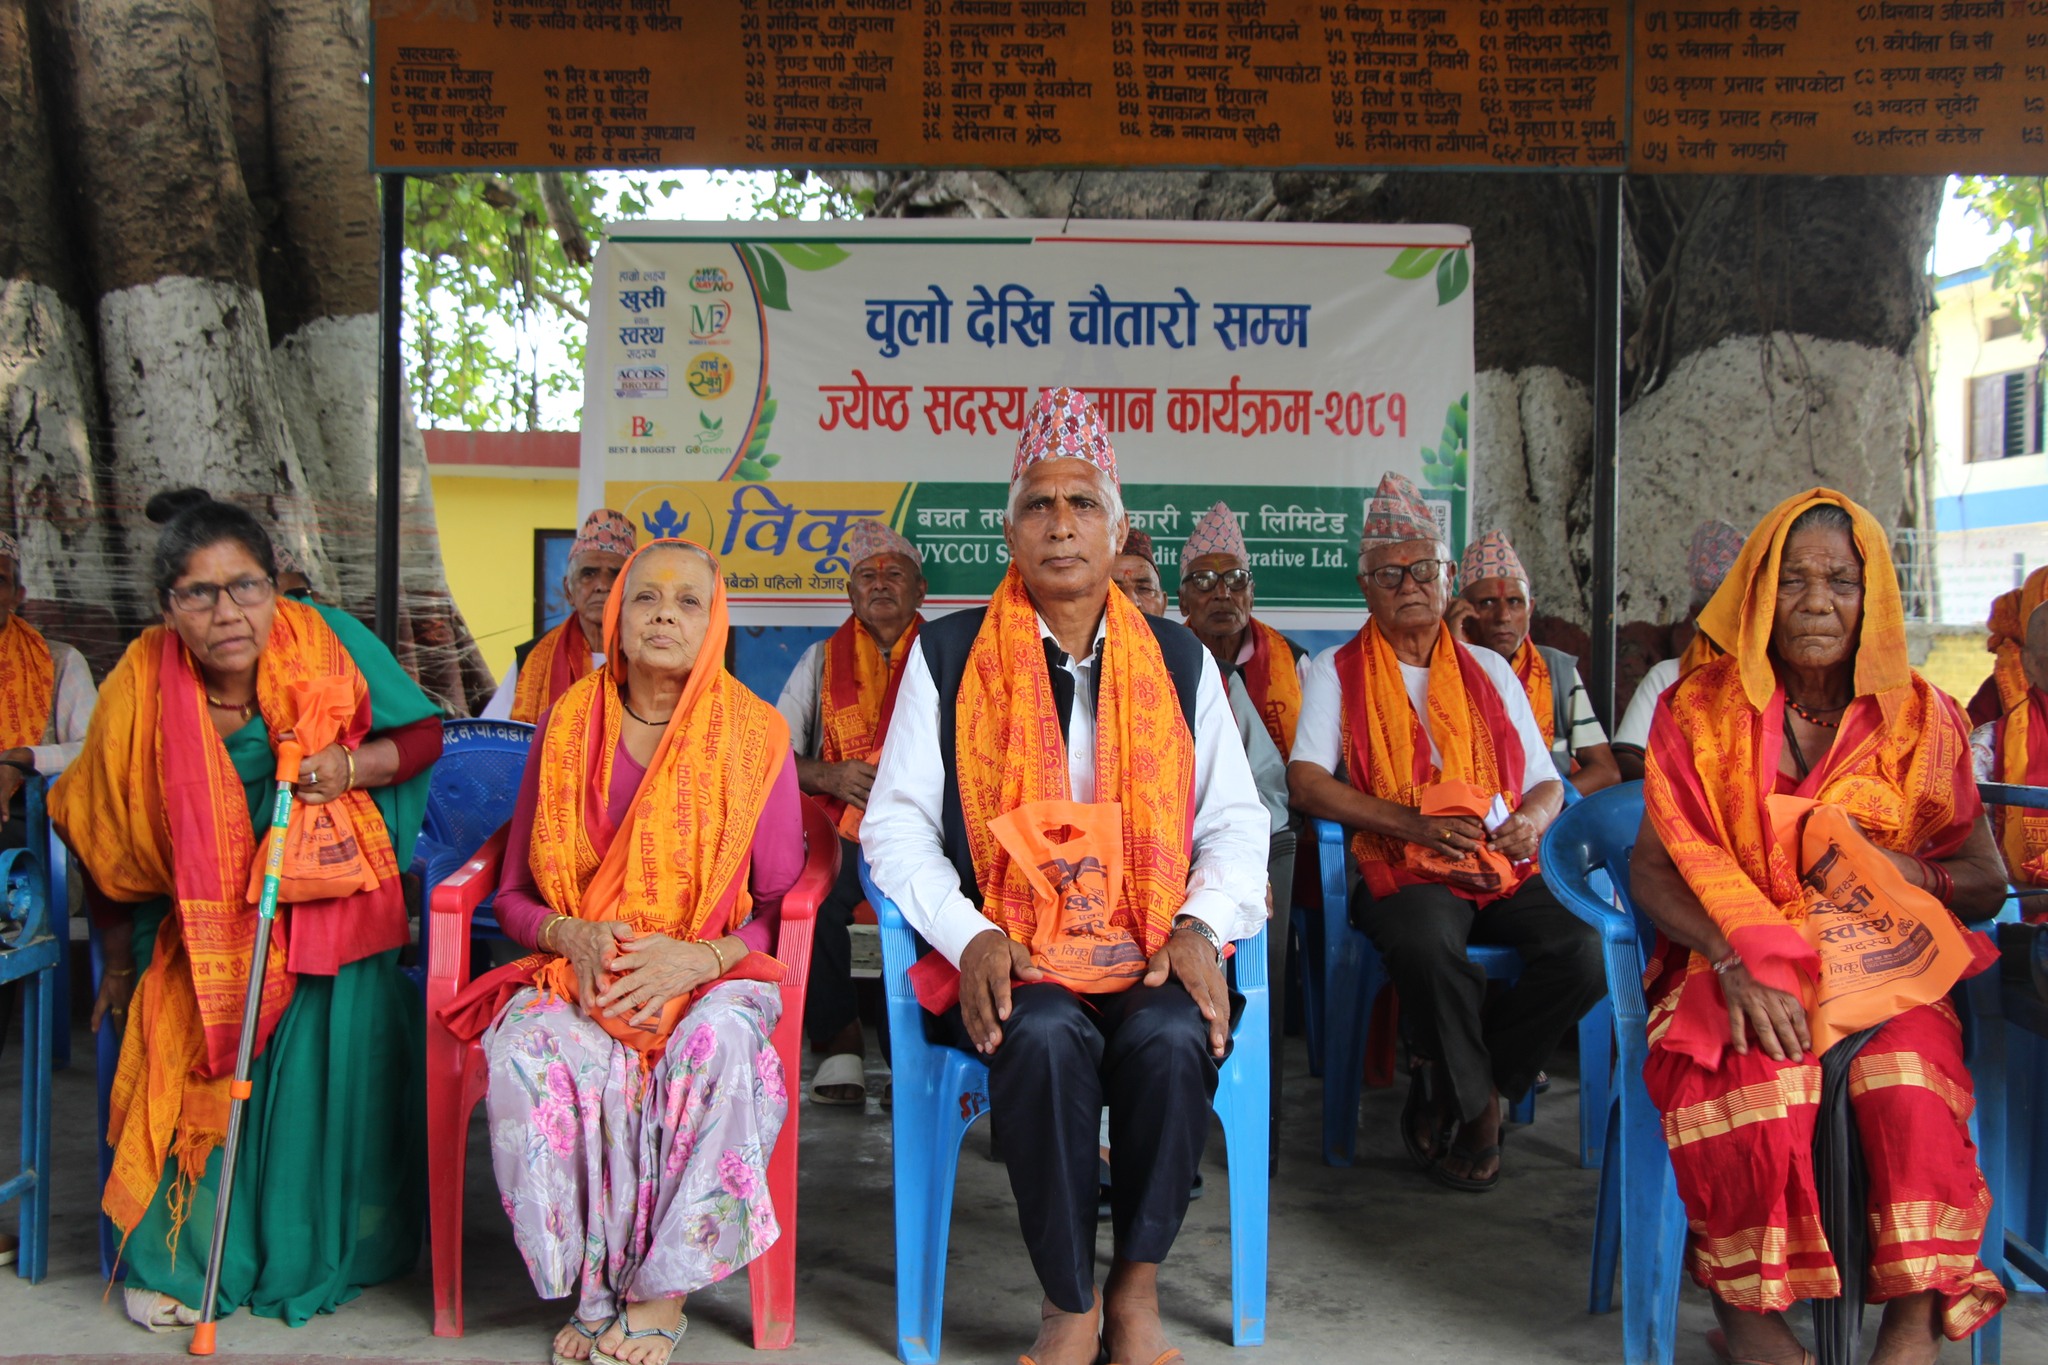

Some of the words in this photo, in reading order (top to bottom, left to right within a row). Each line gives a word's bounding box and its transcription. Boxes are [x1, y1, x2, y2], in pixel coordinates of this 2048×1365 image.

[702, 267, 720, 276] WE
[713, 281, 734, 292] NO
[619, 286, 666, 313] खुसी
[865, 285, 953, 358] चुलो
[966, 285, 1054, 348] देखि
[1068, 284, 1199, 349] चौतारो
[1214, 302, 1311, 352] सम्म
[619, 327, 665, 346] स्वस्थ
[627, 349, 657, 360] सदस्य
[617, 368, 666, 379] ACCESS
[621, 381, 661, 390] BRONZE
[818, 369, 913, 434] ज्येष्ठ
[924, 386, 1028, 435] सदस्य
[1038, 387, 1156, 434] मान
[1168, 376, 1407, 438] कार्यक्रम-२०८१
[608, 446, 629, 454] BEST
[631, 446, 637, 454] &
[640, 446, 676, 454] BIGGEST
[702, 445, 732, 454] Green
[720, 484, 885, 574] विकू
[916, 508, 970, 529] बचत
[979, 508, 1008, 529] तथ
[1128, 504, 1181, 534] कारी
[1259, 504, 1349, 534] लिमिटेड
[916, 543, 989, 563] VYCCU
[1154, 545, 1178, 566] dit
[1247, 548, 1305, 567] erative
[1311, 547, 1349, 567] Ltd.
[764, 573, 802, 590] पहिलो
[1037, 673, 1055, 718] शिवाय
[706, 700, 725, 762] श्रीसीताराम
[1043, 720, 1056, 747] नमः
[673, 763, 692, 838] श्रीसीताराम
[641, 831, 659, 905] श्रीसीताराम
[1832, 871, 1858, 900] लक्ष्य
[1818, 911, 1894, 944] स्वस्थ
[1060, 942, 1090, 961] विकू
[1837, 936, 1892, 953] सदस्य
[1829, 960, 1860, 977] विकू
